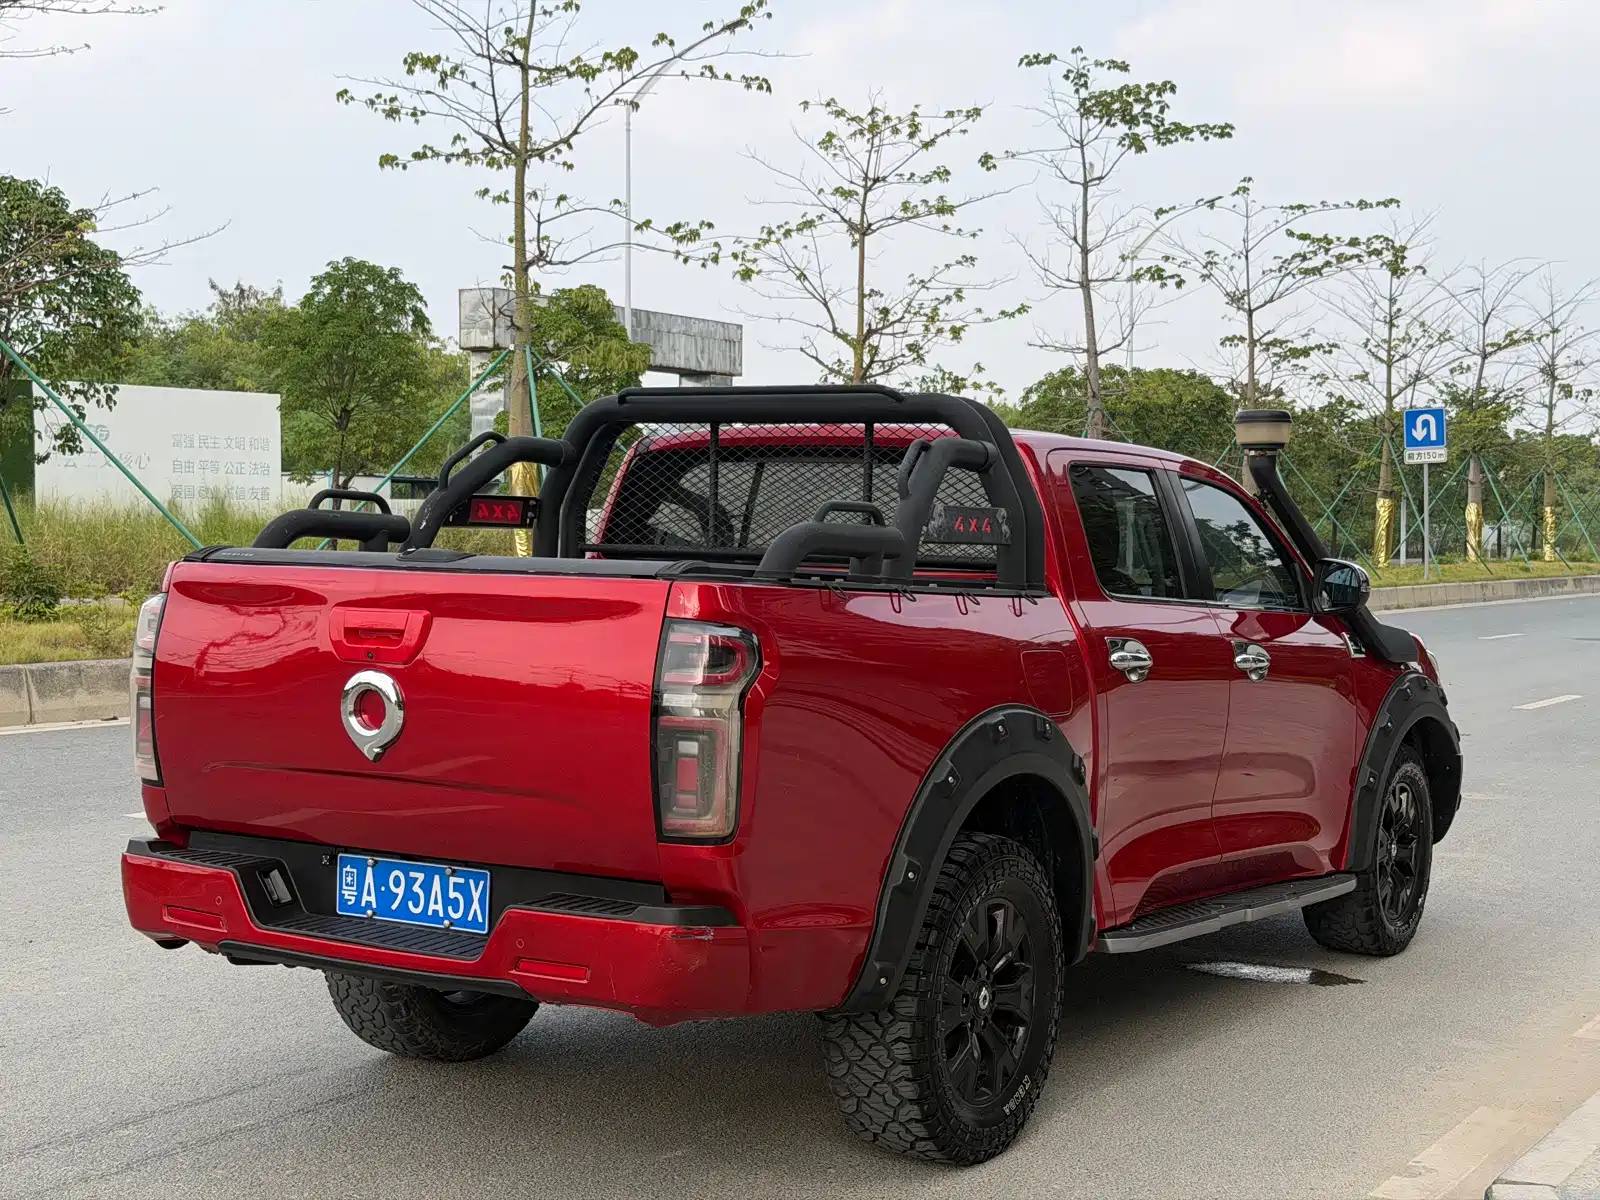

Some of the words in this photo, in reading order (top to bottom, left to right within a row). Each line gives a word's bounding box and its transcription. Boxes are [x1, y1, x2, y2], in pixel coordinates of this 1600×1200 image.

[198, 434, 221, 450] 民主
[223, 436, 246, 451] 文明
[172, 459, 195, 475] 自由
[197, 460, 221, 475] 平等
[224, 461, 246, 476] 公正
[248, 461, 271, 477] 法治
